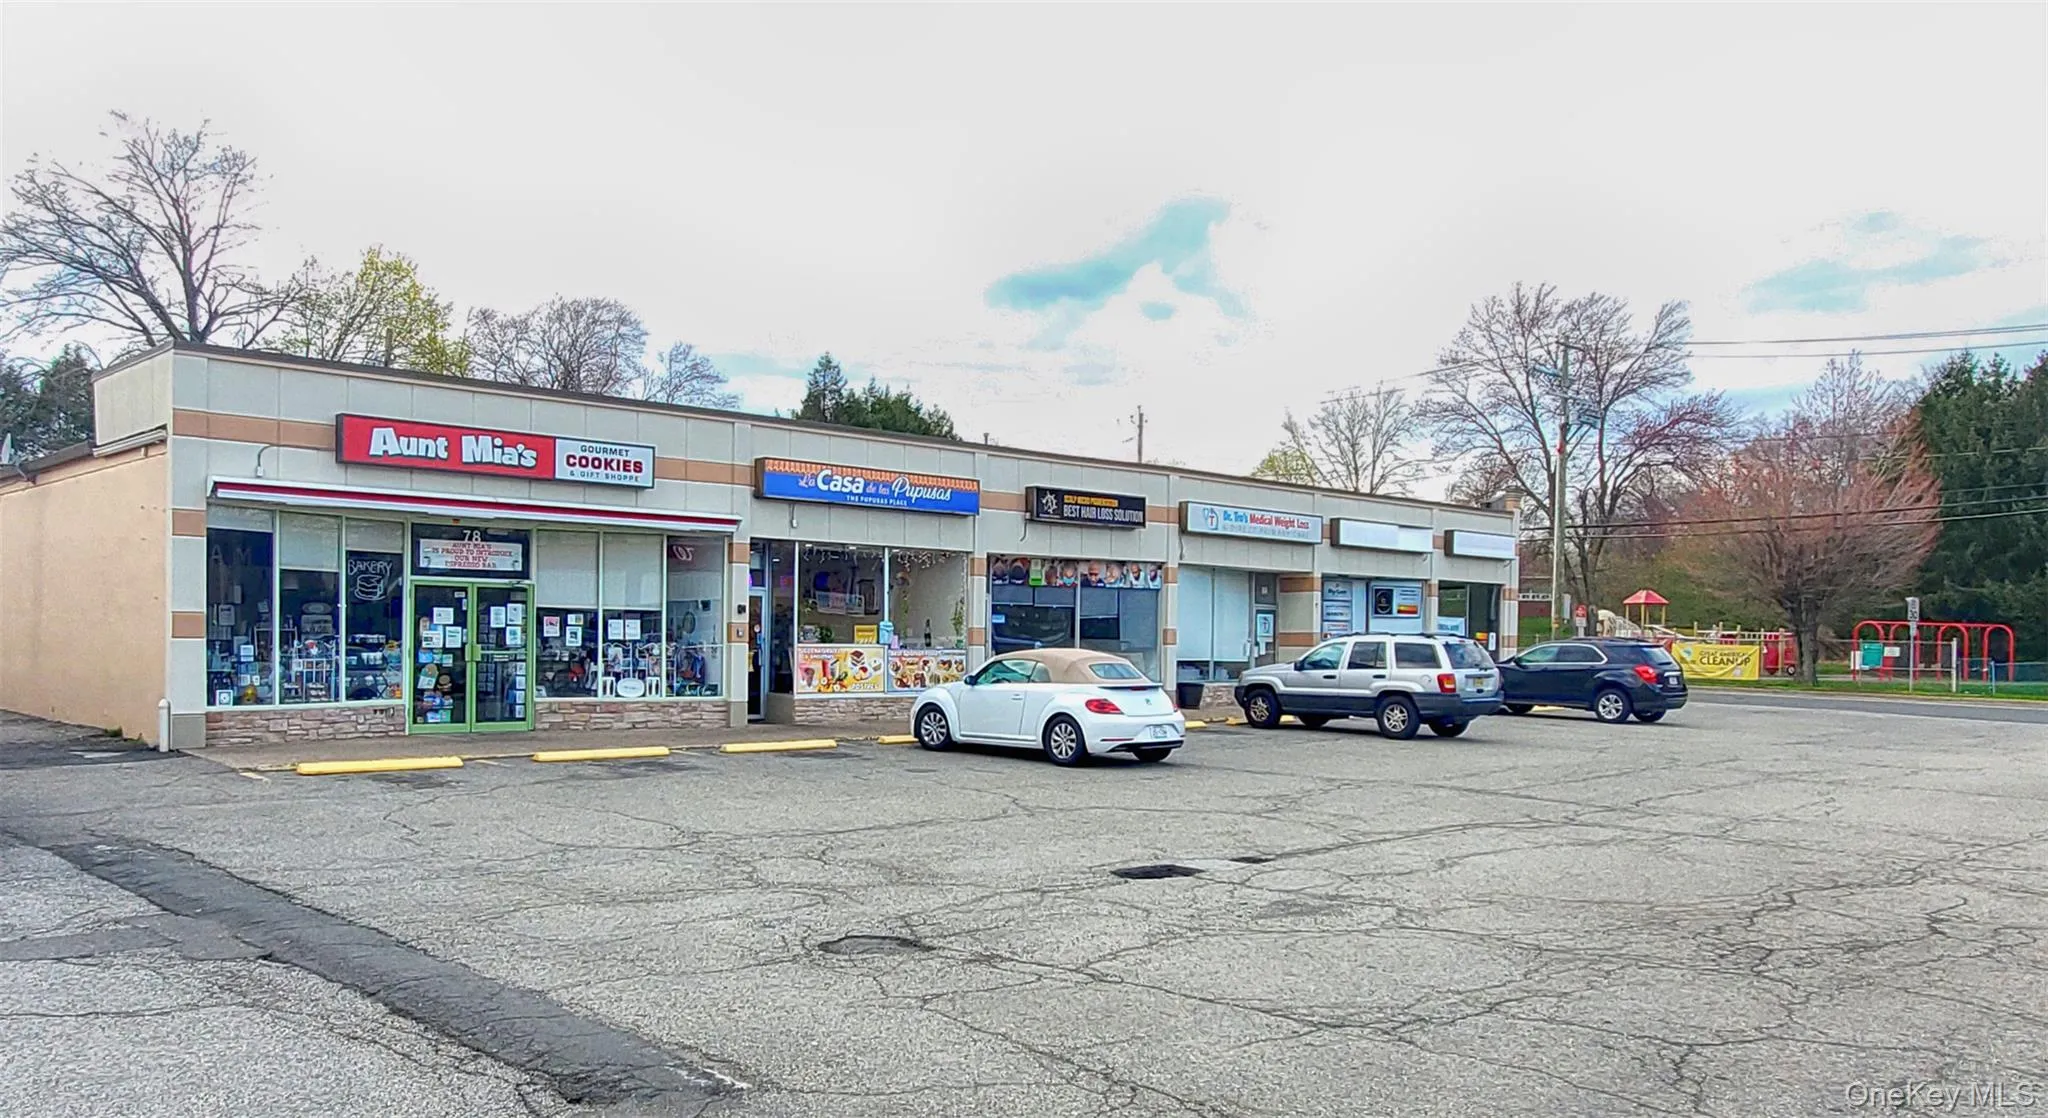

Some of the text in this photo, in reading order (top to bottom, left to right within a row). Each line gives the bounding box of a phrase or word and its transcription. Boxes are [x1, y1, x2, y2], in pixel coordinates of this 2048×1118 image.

[369, 427, 537, 468] Aunt Mia's
[580, 445, 630, 457] GOURMET
[566, 454, 643, 473] COOKIES
[604, 473, 640, 482] SHOPPE
[798, 475, 816, 488] La
[816, 469, 865, 494] Casa
[866, 482, 876, 493] de
[891, 476, 951, 503] Pupusas
[860, 496, 888, 504] PUPUSAS
[889, 498, 908, 506] PLACE
[1063, 505, 1144, 523] BEST HAIR LOSS SOLUTION
[1223, 510, 1233, 521] Dr.
[1249, 512, 1273, 525] Medical
[1274, 516, 1296, 529] Weight
[1297, 519, 1310, 529] Loss
[463, 530, 481, 542] 78
[348, 559, 392, 576] BAKERY
[1700, 656, 1751, 666] CLEANUP
